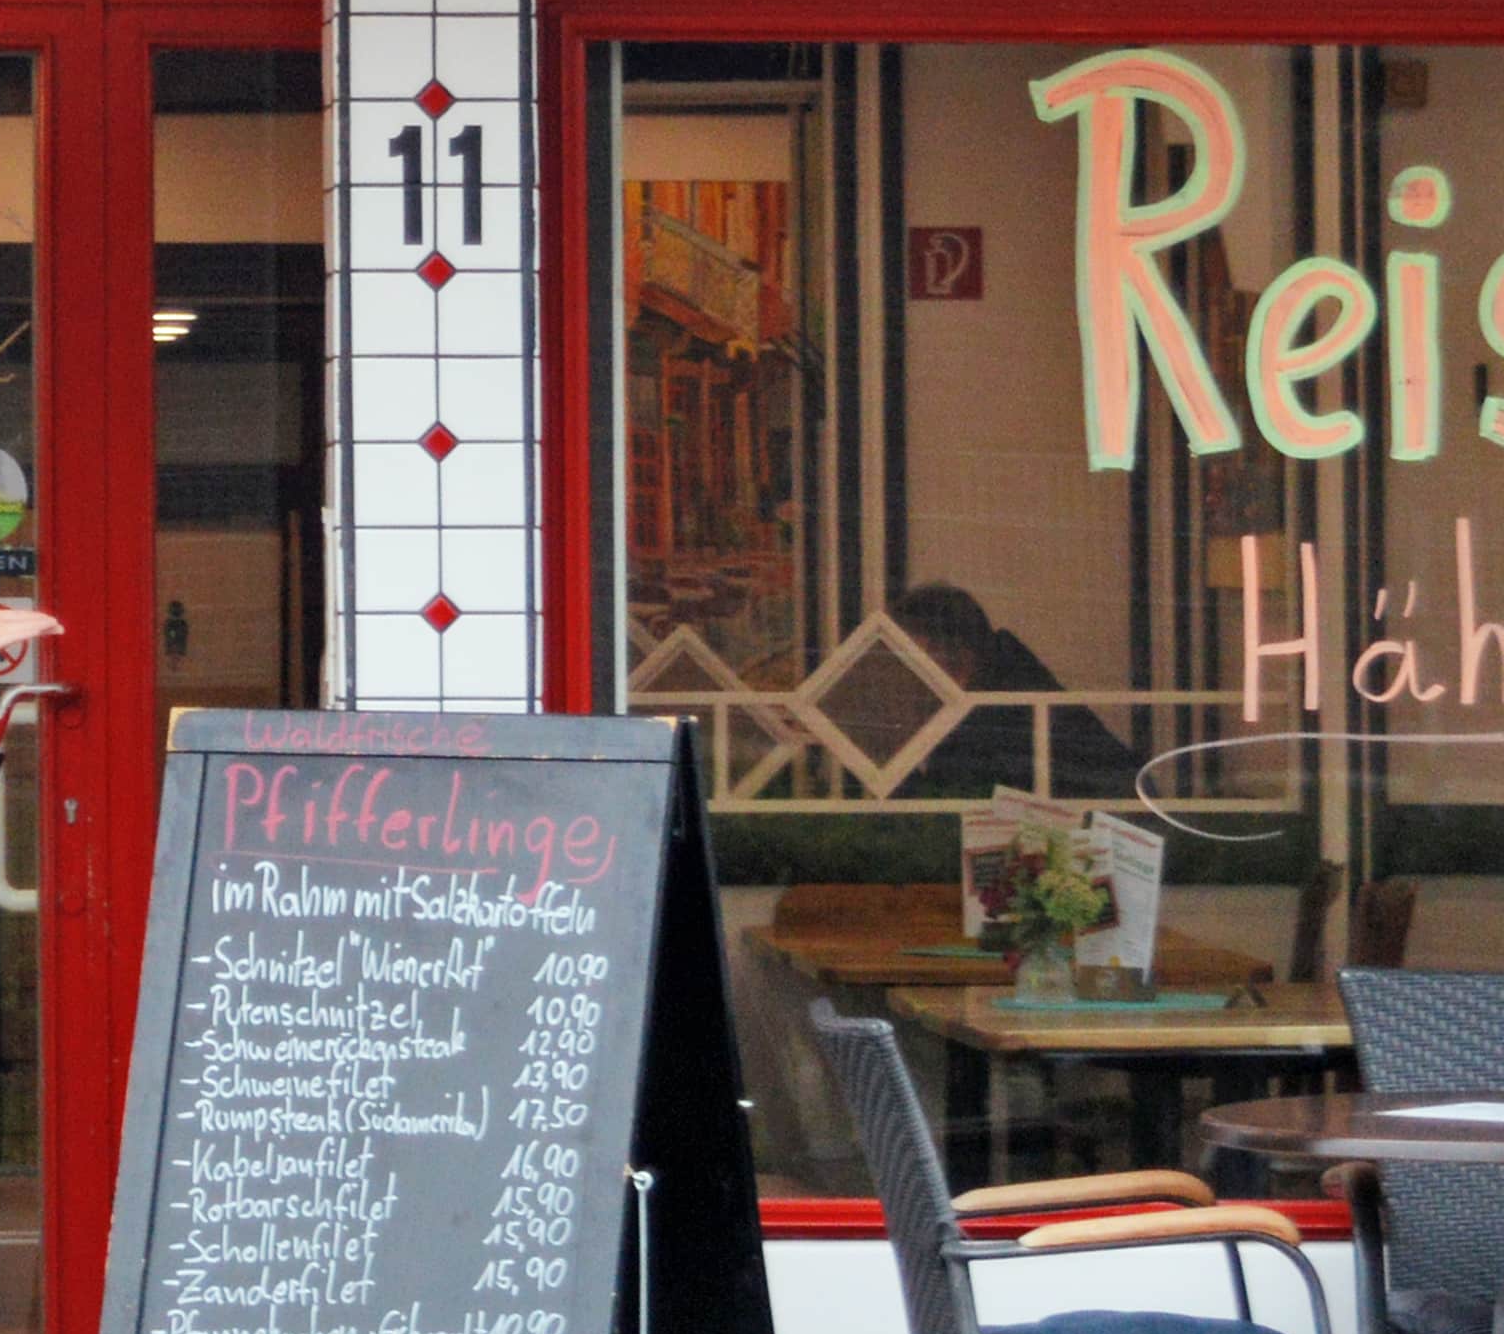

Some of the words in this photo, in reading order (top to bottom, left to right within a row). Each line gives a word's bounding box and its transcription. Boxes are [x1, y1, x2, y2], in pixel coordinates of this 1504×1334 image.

[388, 125, 483, 246] 11
[224, 762, 612, 906] Pfifferlinge
[212, 861, 255, 914] im
[253, 861, 349, 920] Rahm
[353, 866, 410, 922] mit
[410, 871, 597, 935] Salzkartoffeln
